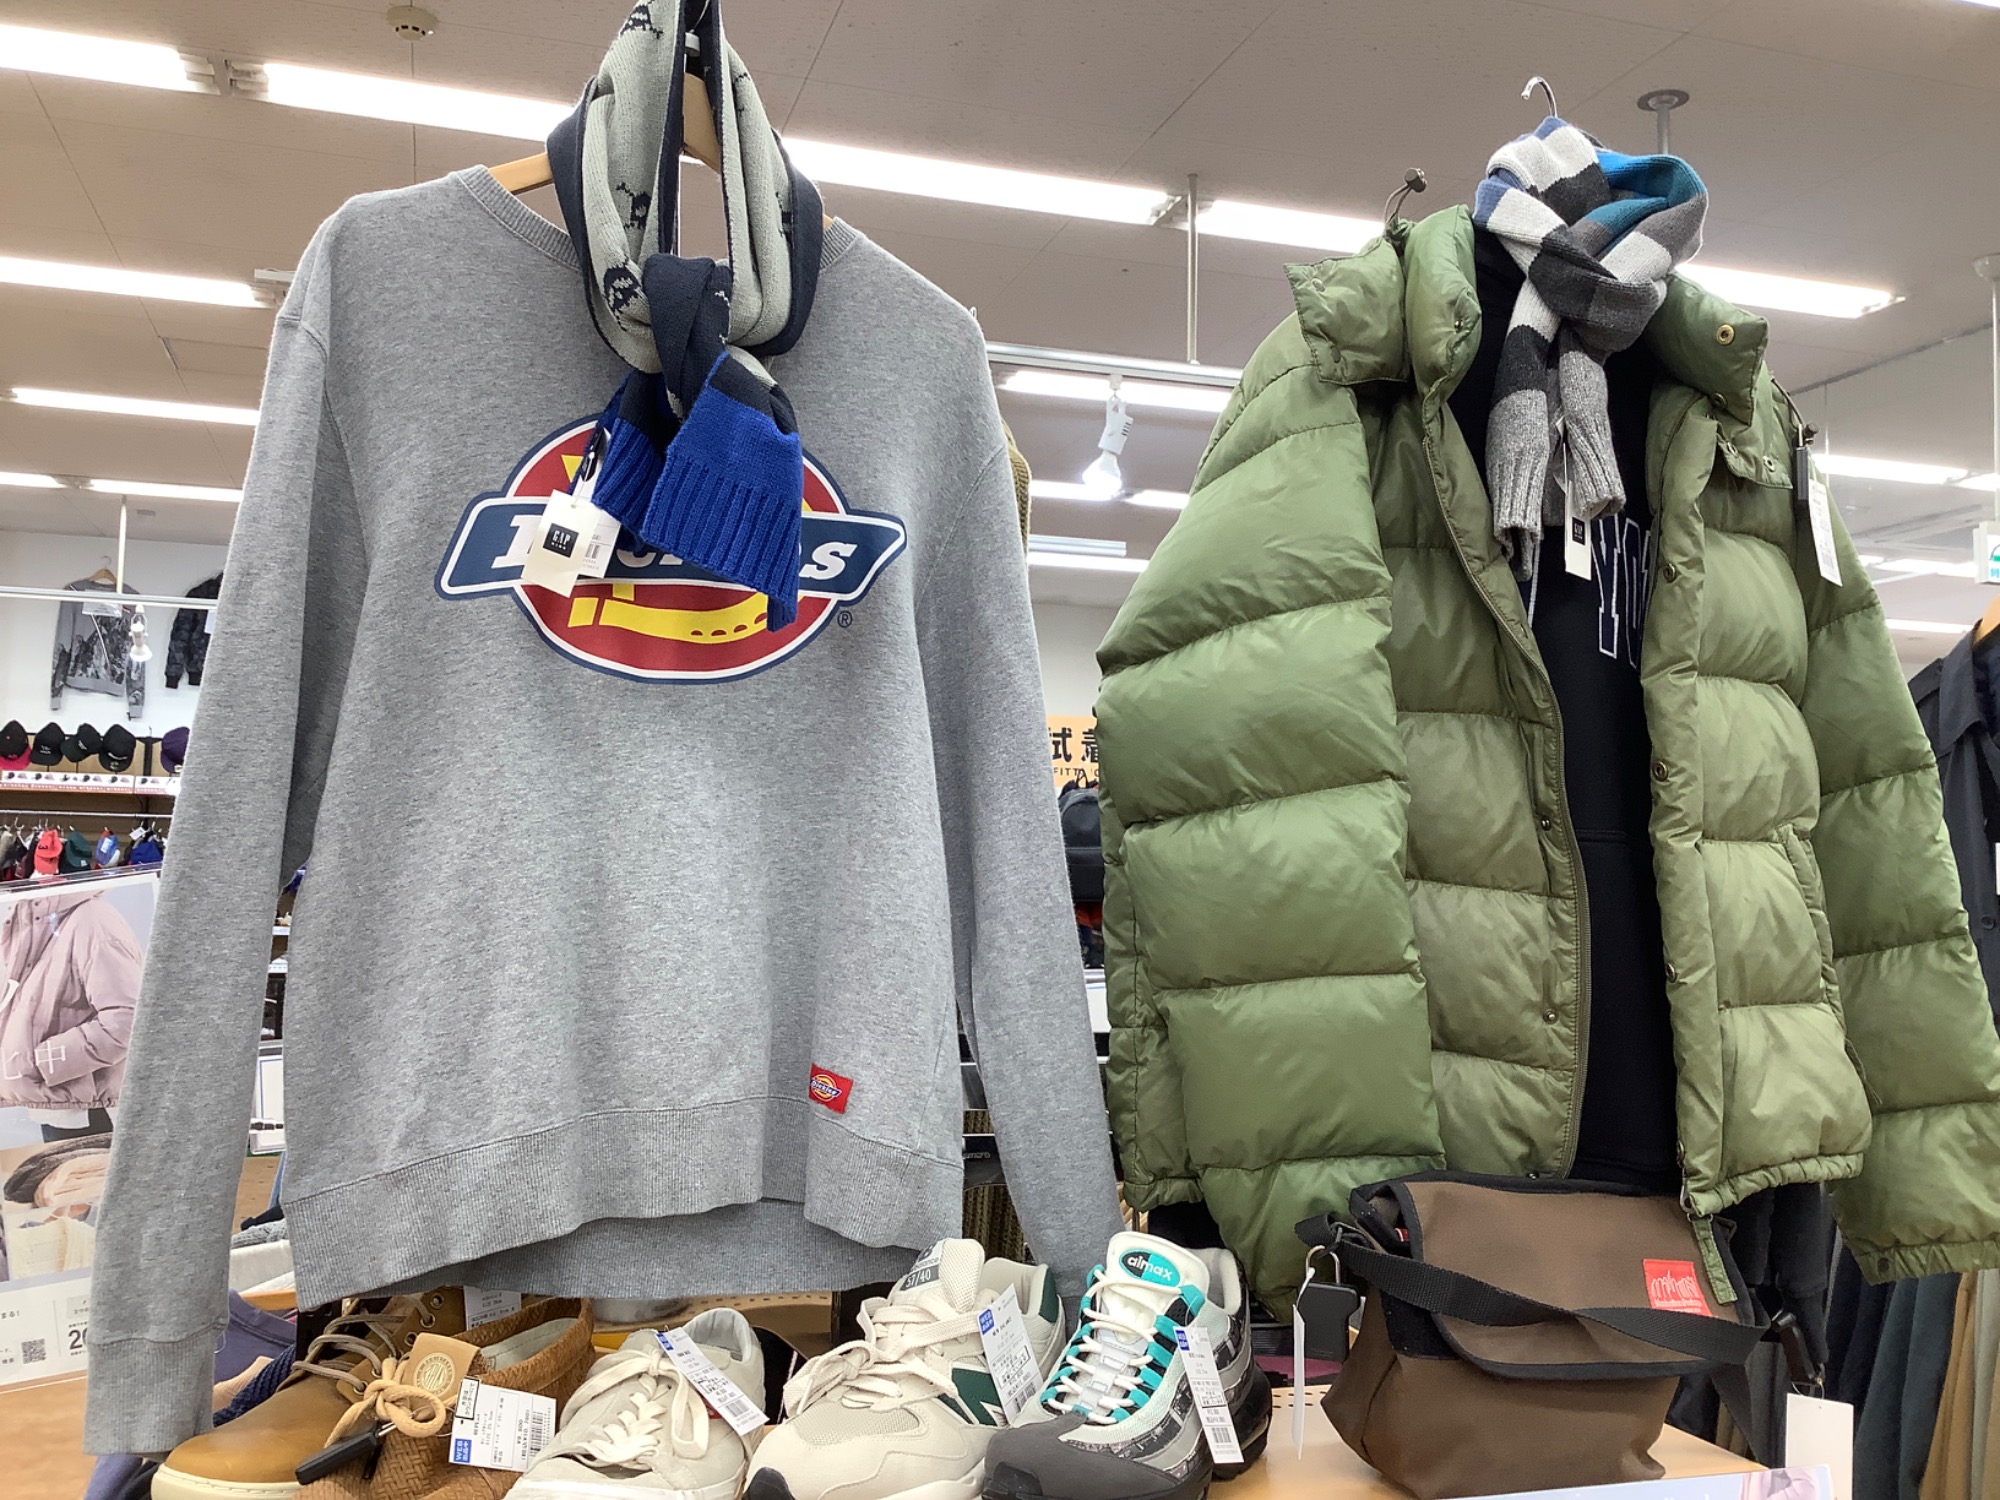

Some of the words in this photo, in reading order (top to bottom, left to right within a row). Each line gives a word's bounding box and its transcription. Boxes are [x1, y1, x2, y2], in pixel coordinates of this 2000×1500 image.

[552, 530, 572, 546] GAP
[811, 1080, 838, 1096] Dickies
[905, 1268, 931, 1288] 57/40
[455, 1440, 463, 1461] WEB
